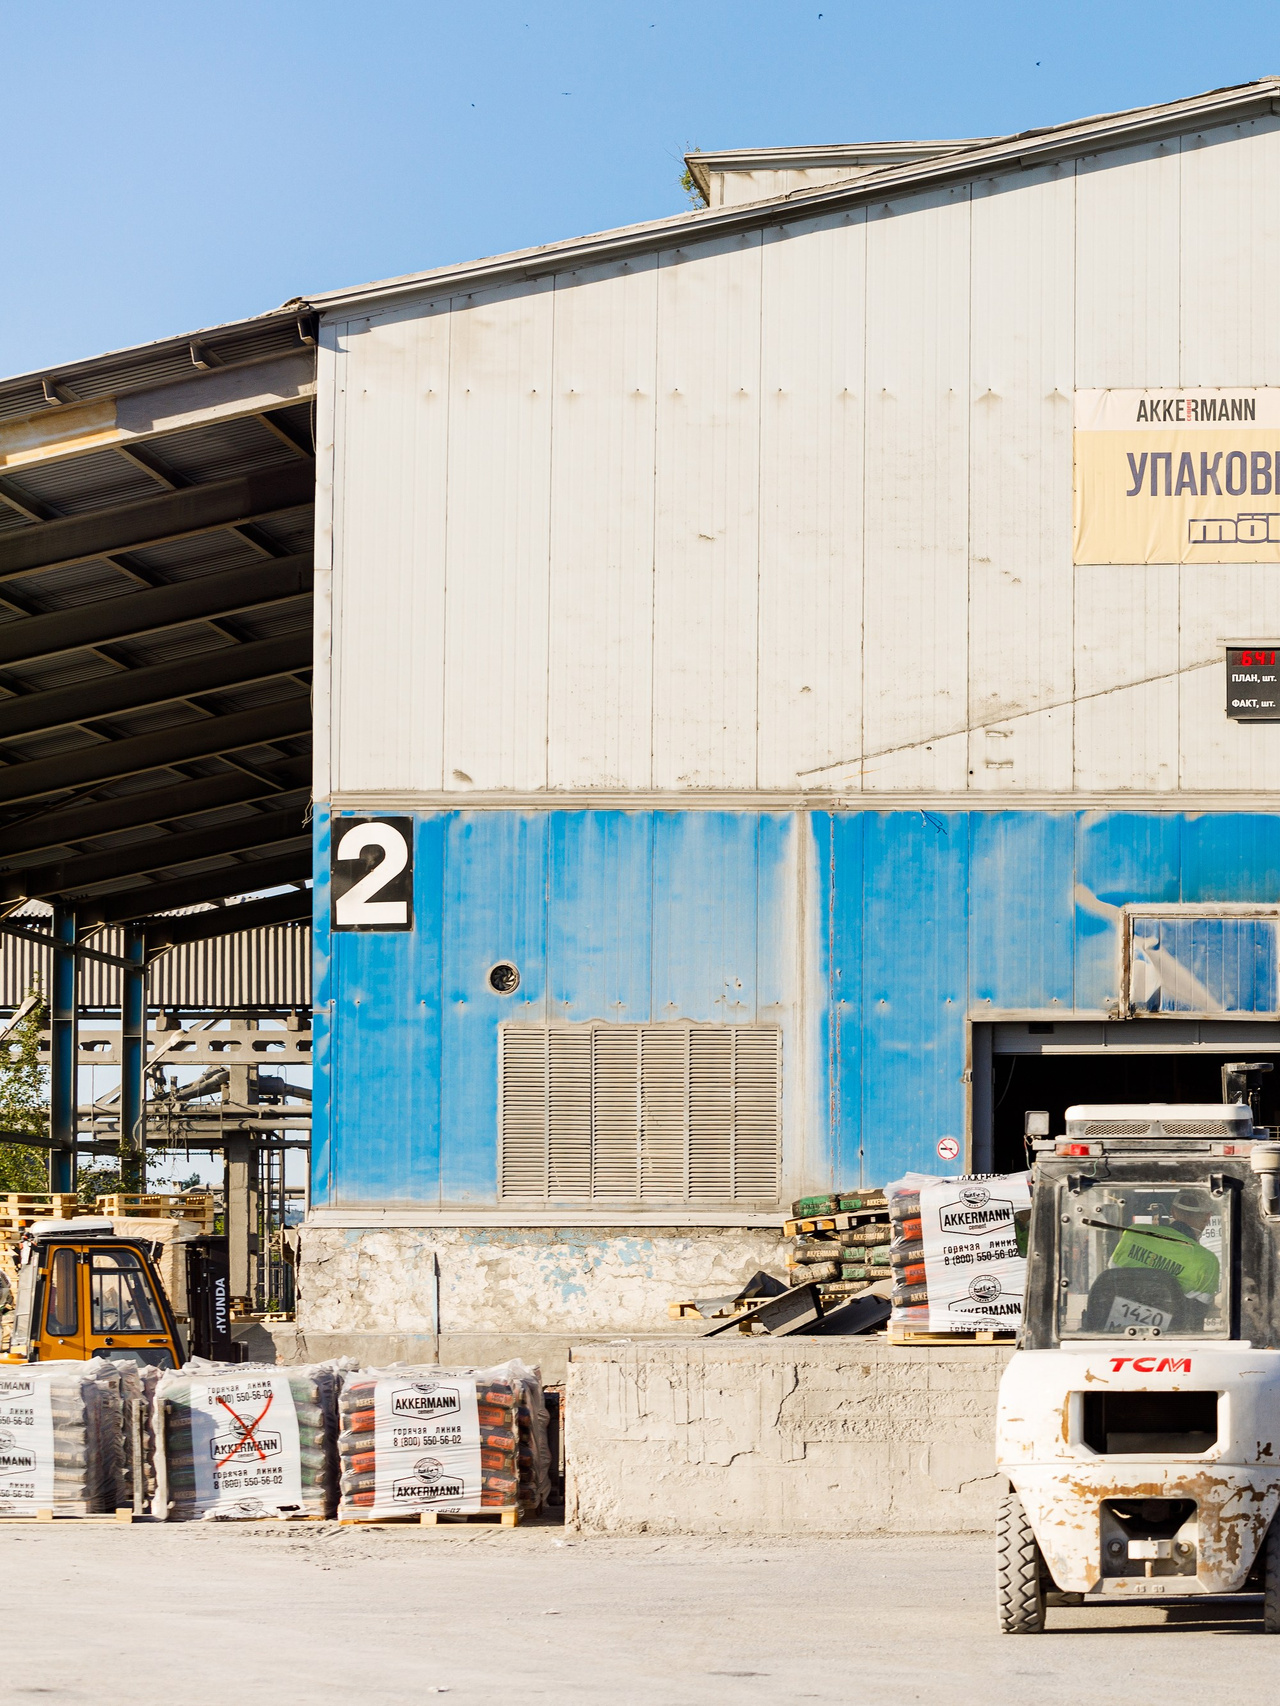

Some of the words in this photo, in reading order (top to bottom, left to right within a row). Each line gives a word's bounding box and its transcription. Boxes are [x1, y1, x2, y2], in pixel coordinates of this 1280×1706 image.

[1136, 398, 1256, 422] AKKERMANN
[1241, 650, 1276, 666] 641
[1231, 674, 1260, 683] ПЛАН,
[1231, 699, 1259, 708] ФАКТ,
[335, 821, 409, 925] 2
[943, 1208, 1011, 1227] AKKERMANN
[943, 1242, 981, 1255] горячая
[944, 1256, 950, 1266] 8
[952, 1254, 974, 1266] (800)
[976, 1247, 1019, 1263] 550-56-02
[1127, 1244, 1185, 1277] AKKERMANN
[1121, 1303, 1164, 1327] 1420
[1109, 1357, 1192, 1373] TCM
[395, 1396, 457, 1410] AKKERMANN
[393, 1427, 427, 1436] горячая
[435, 1425, 462, 1434] линия
[213, 1439, 278, 1456] AKKERMANN
[393, 1437, 398, 1447] 8
[400, 1435, 421, 1447] (800)
[423, 1434, 462, 1446] 550-56-02
[213, 1470, 248, 1480] горячая
[256, 1466, 283, 1475] линия
[213, 1480, 220, 1490] 8
